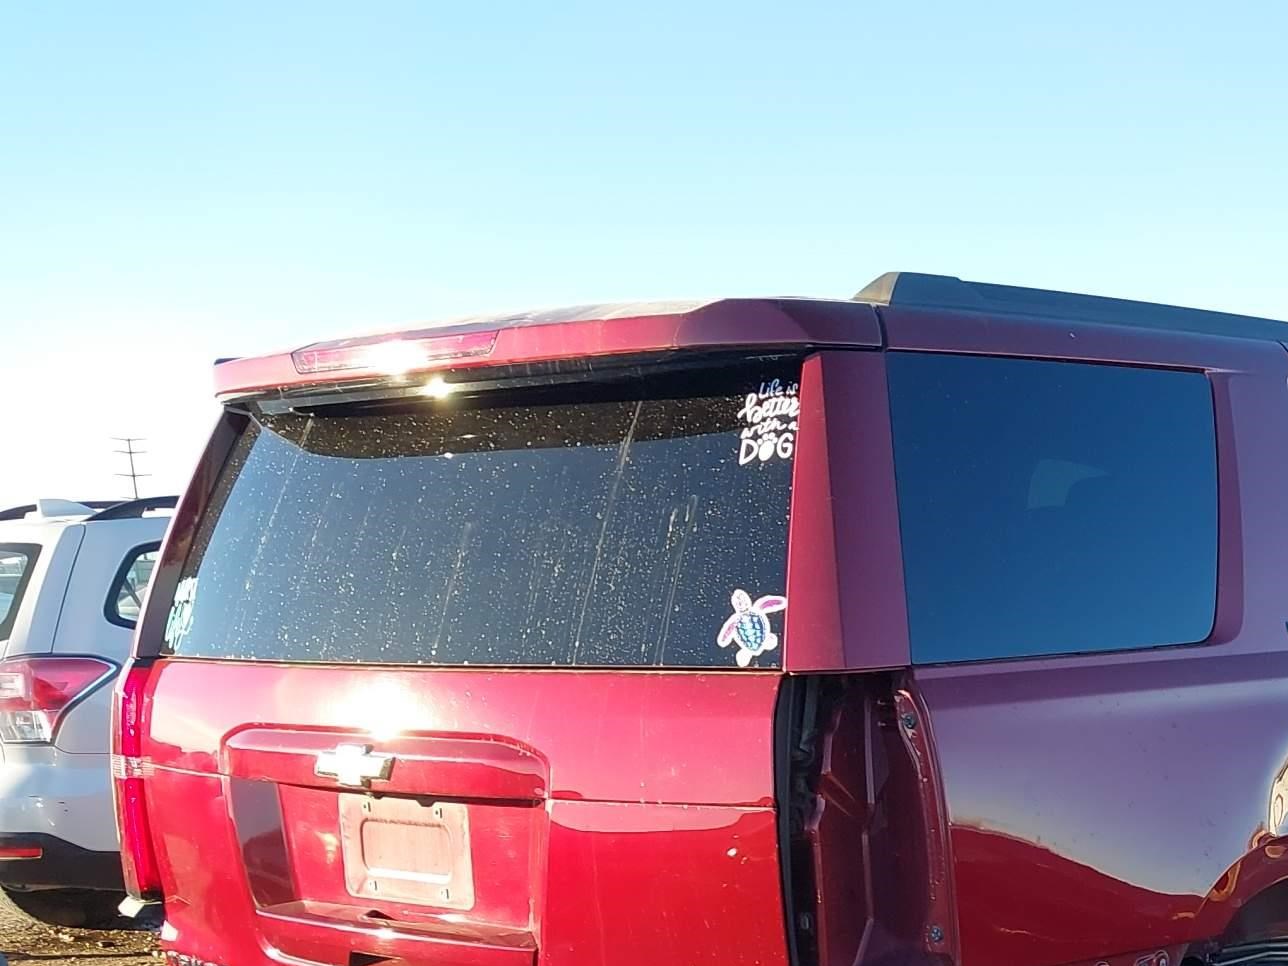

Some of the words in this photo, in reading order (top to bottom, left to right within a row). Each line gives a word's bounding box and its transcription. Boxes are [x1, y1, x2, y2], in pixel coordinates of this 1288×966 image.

[758, 378, 783, 399] Life
[785, 381, 799, 395] is
[737, 393, 801, 423] better
[740, 418, 787, 439] with
[788, 421, 800, 431] a
[739, 432, 794, 465] DOG
